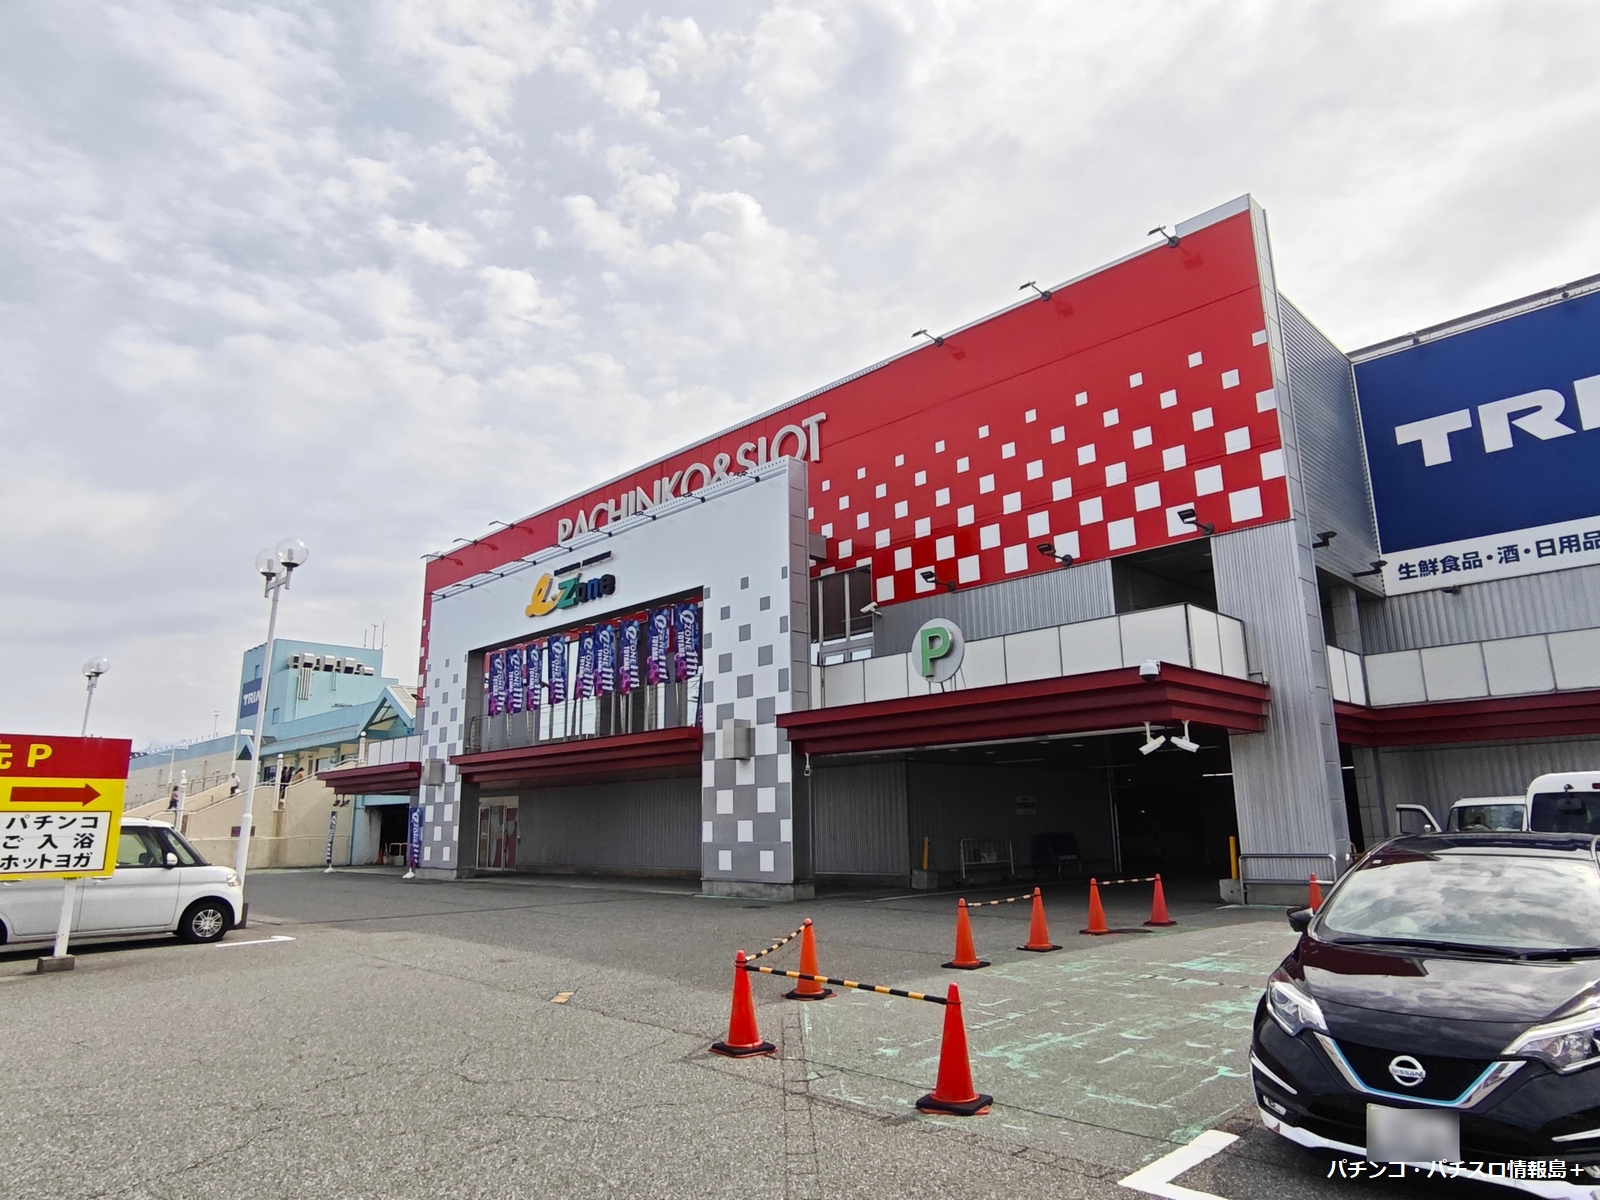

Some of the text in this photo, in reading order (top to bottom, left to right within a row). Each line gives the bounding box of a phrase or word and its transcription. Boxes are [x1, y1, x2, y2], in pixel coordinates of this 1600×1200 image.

[677, 631, 686, 658] TOYAMA
[920, 626, 952, 678] P
[5, 814, 99, 830] パチンコ
[2, 833, 95, 850] ご入浴
[0, 852, 93, 870] ホットヨガ
[1391, 1067, 1425, 1080] NISSAN
